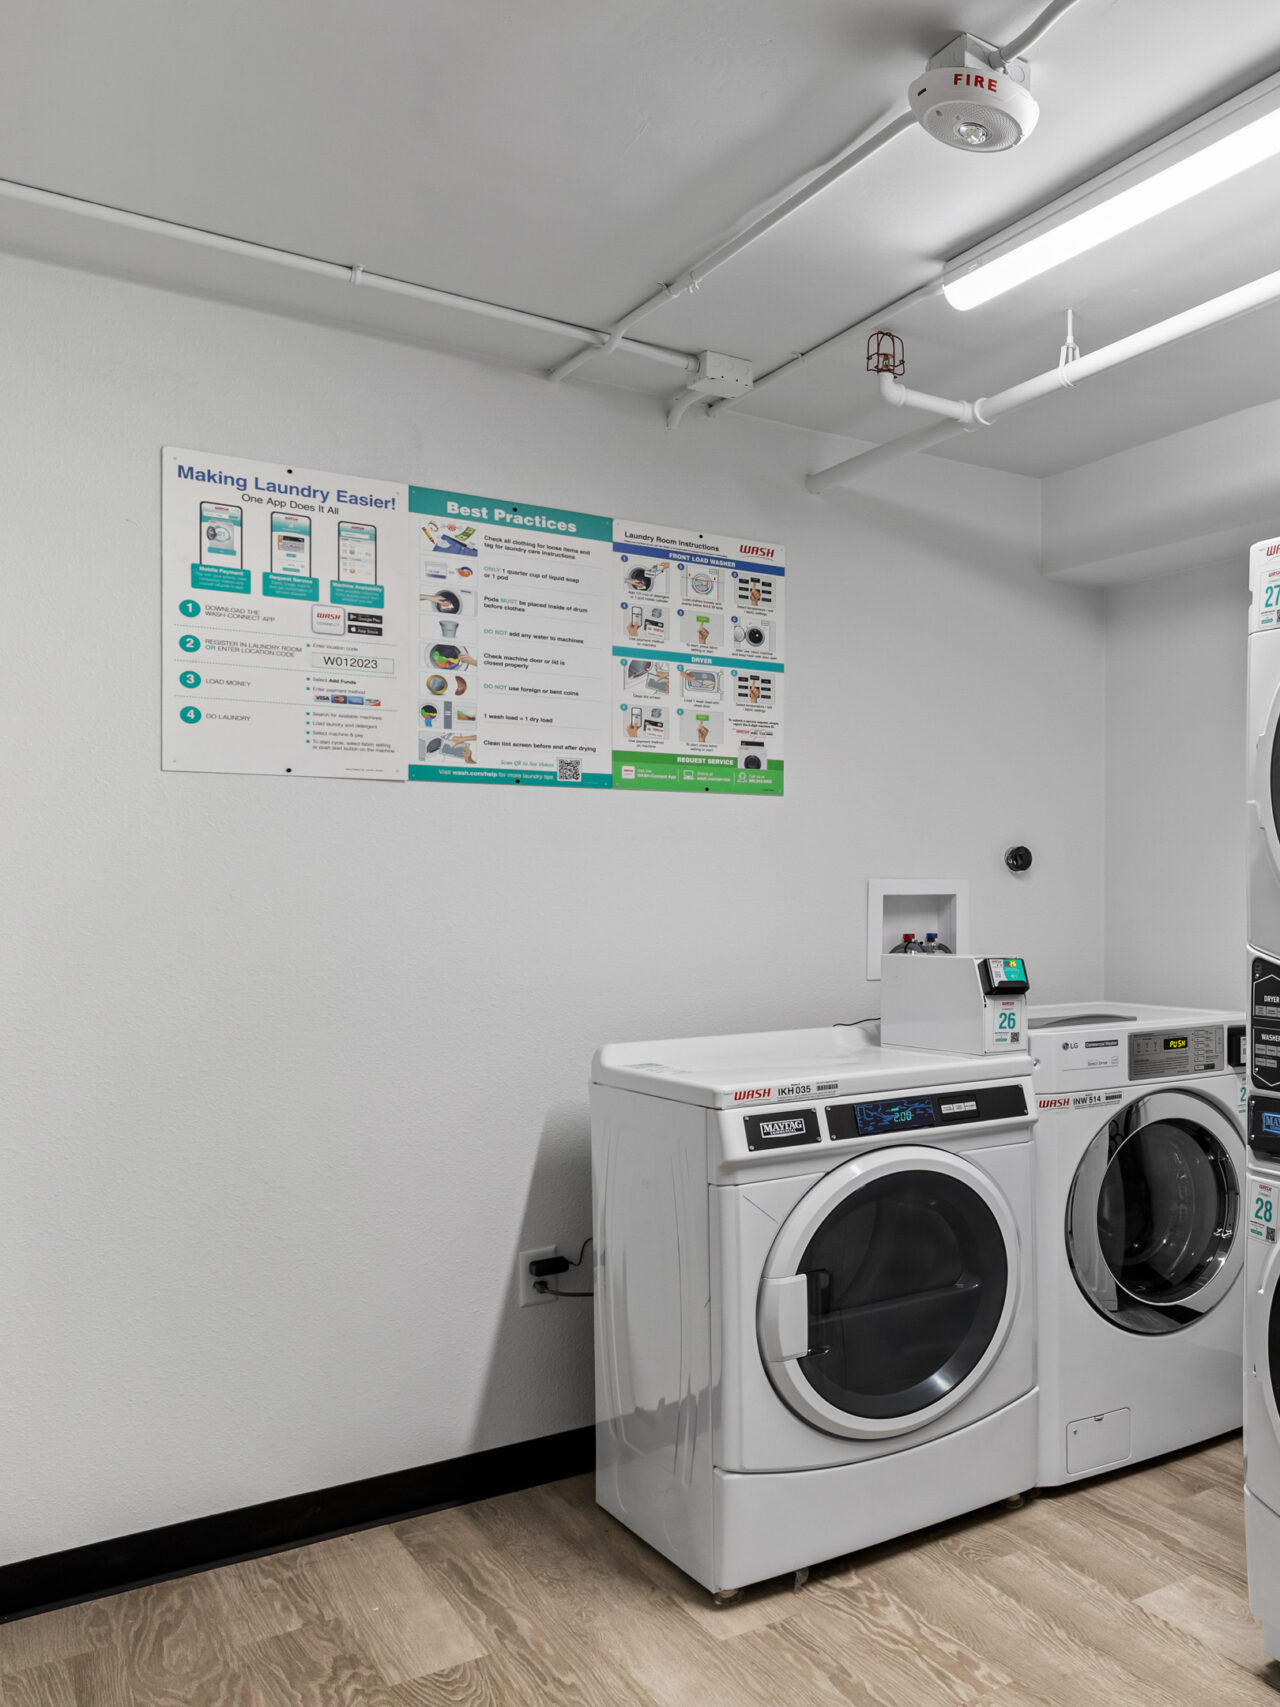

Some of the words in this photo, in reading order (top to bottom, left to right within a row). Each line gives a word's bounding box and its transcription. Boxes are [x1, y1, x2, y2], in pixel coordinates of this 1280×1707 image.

[954, 74, 998, 92] FIRE
[177, 465, 248, 492] Making
[254, 476, 330, 503] Laundry
[336, 490, 396, 510] Easier!
[242, 493, 264, 505] One
[267, 497, 286, 509] App
[290, 500, 316, 512] Does
[318, 504, 326, 513] It
[328, 505, 339, 516] All
[446, 501, 489, 519] Best
[494, 509, 578, 533] Practices
[624, 531, 654, 543] Laundry
[656, 536, 677, 546] Room
[678, 540, 720, 552] Instructions
[739, 544, 775, 558] WASH
[668, 552, 690, 562] FRONT
[692, 556, 708, 564] LOAD
[710, 558, 736, 568] WASHER
[186, 603, 192, 612] 1
[316, 612, 340, 620] WASH
[186, 638, 194, 648] 2
[324, 656, 378, 669] W012023
[691, 657, 712, 665] DRYER
[186, 674, 194, 684] 3
[206, 678, 224, 686] LOAD
[186, 709, 194, 719] 4
[218, 714, 251, 722] LAUNDRY
[677, 756, 706, 764] REQUEST
[708, 758, 734, 766] SERVICE
[1264, 995, 1280, 1004] DRYER
[998, 1012, 1016, 1030] 26
[1169, 1040, 1186, 1048] PUSH
[734, 1088, 771, 1100] WASH
[778, 1086, 794, 1096] IKH
[796, 1085, 811, 1094] 035
[1240, 1087, 1246, 1102] 2
[1038, 1098, 1070, 1109] WASH
[1073, 1096, 1088, 1106] INW
[1088, 1095, 1102, 1104] 514
[893, 1111, 912, 1123] 2.00
[763, 1120, 803, 1133] MAYTAG
[1254, 1197, 1273, 1222] 28
